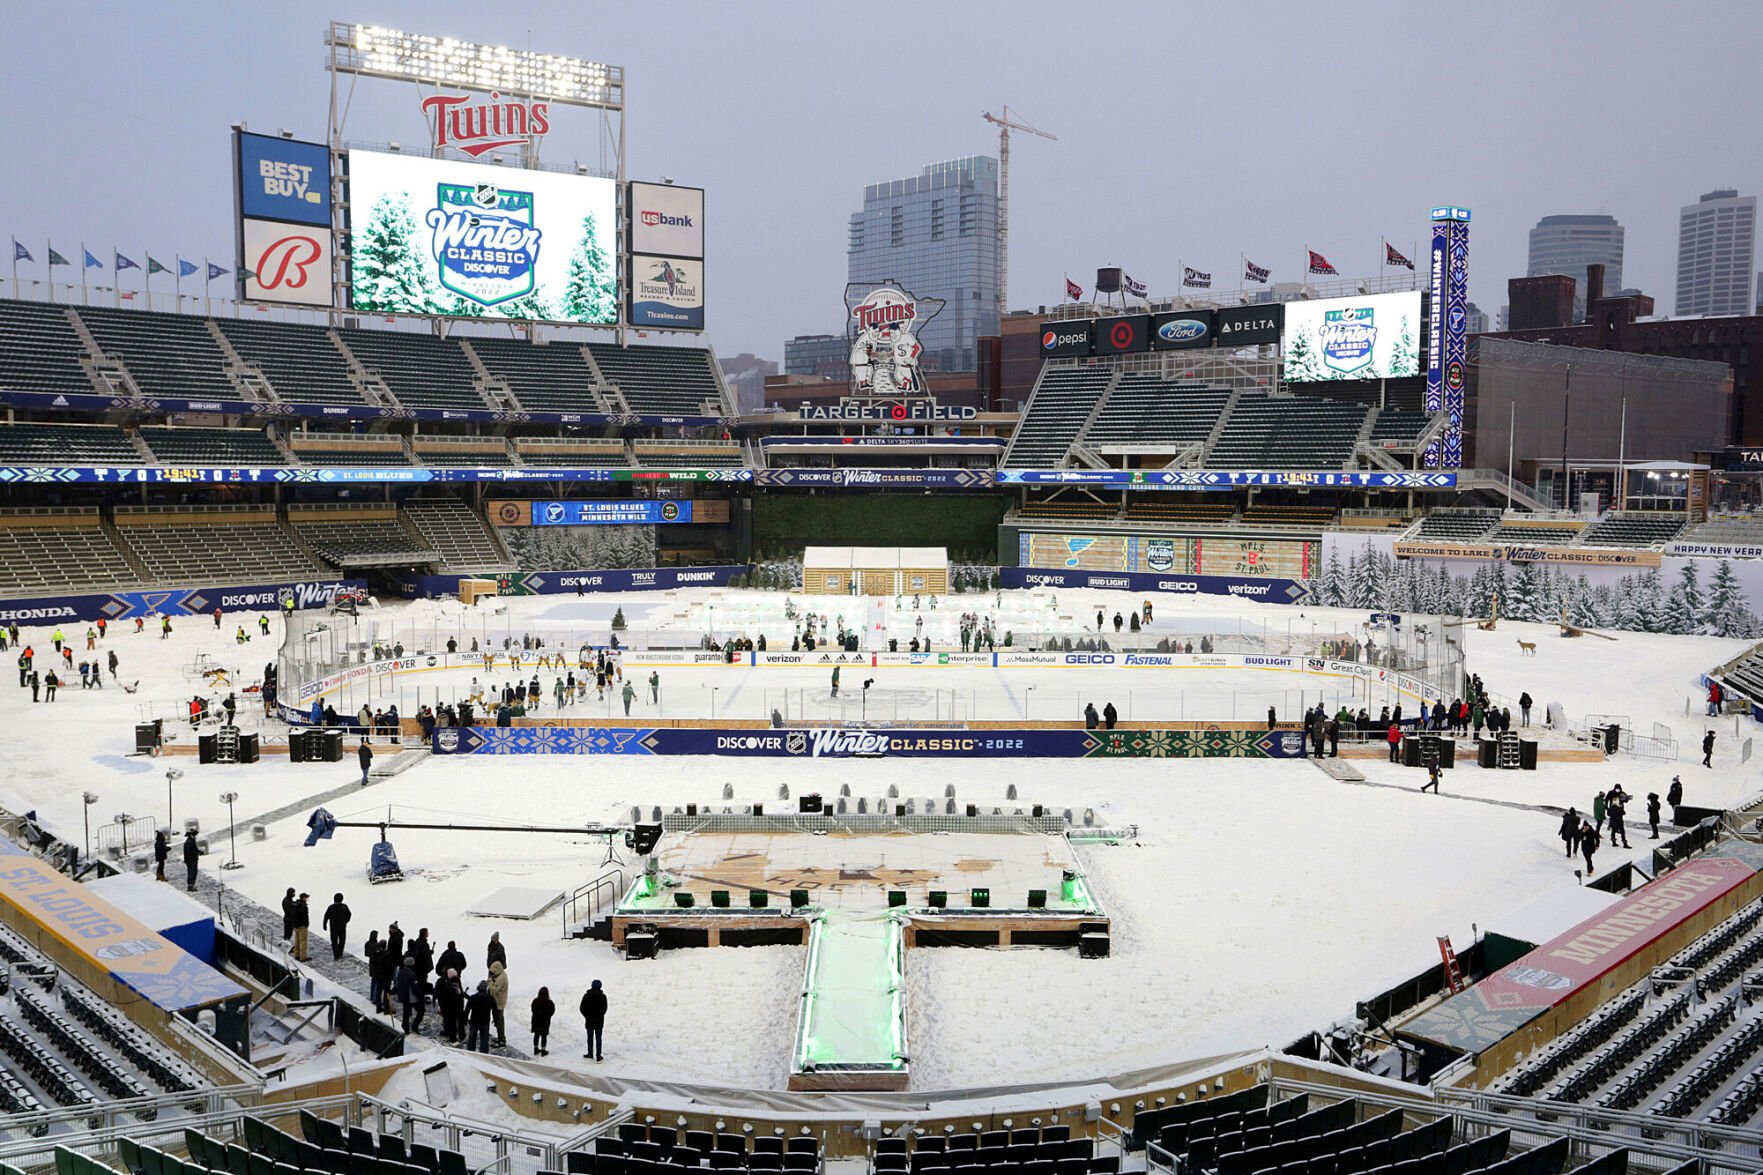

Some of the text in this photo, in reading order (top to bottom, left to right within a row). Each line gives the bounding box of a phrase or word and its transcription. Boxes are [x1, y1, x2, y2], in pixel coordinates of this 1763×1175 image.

[422, 91, 550, 147] Twins
[259, 159, 312, 183] BEST
[264, 177, 308, 199] BUY
[427, 208, 542, 263] Winter
[447, 247, 525, 264] CLASSIC
[256, 236, 321, 290] B
[464, 262, 511, 275] DISCOVER
[640, 282, 696, 297] Treasure Island
[853, 300, 915, 331] Twins
[1429, 249, 1442, 369] #WINTERCLASSIC
[1168, 324, 1197, 338] Ford
[1234, 319, 1275, 332] DELTA
[1058, 331, 1087, 346] pepsi
[1319, 325, 1377, 353] Winter
[1328, 342, 1369, 351] CLASSIC
[800, 406, 977, 419] TARGET FIELD
[163, 468, 199, 479] 19:41
[799, 473, 831, 481] DISCOVER
[843, 470, 882, 487] Winter
[1283, 473, 1313, 482] 19:41
[1240, 542, 1266, 553] MPLS.
[1674, 544, 1762, 556] HAPPY NEW YEAR
[1397, 547, 1445, 555] WELCOME
[1505, 546, 1547, 560] Winter
[1547, 553, 1593, 561] CLASSIC
[1598, 555, 1636, 563] DISCOVER
[1235, 562, 1271, 575] ST. PAUL
[560, 576, 603, 586] DISCOVER
[677, 571, 716, 582] DUNKIN'
[1026, 574, 1065, 585] DISCOVER
[1089, 578, 1128, 587] BUD LIGHT
[1159, 581, 1198, 591] GEICO
[1228, 584, 1266, 595] verizon
[222, 592, 275, 607] DISCOVER
[1, 606, 76, 621] HONDA
[911, 654, 927, 663] SAP
[942, 655, 987, 663] enterprise
[1014, 655, 1056, 663] MassMutual
[1066, 655, 1115, 664] GEICO
[1124, 655, 1173, 665] FASTENAL
[1245, 657, 1265, 665] BUD
[1308, 659, 1325, 667] SN
[376, 659, 416, 673] DISCOVER
[1331, 662, 1353, 673] Great
[301, 681, 323, 699] GEICO
[717, 736, 781, 750] DISCOVER
[809, 729, 890, 757] Winter
[890, 739, 974, 751] CLASSIC
[986, 740, 1023, 749] 2022
[1, 867, 125, 939] ST. LOUIS
[1549, 871, 1724, 965] MINNESOTA
